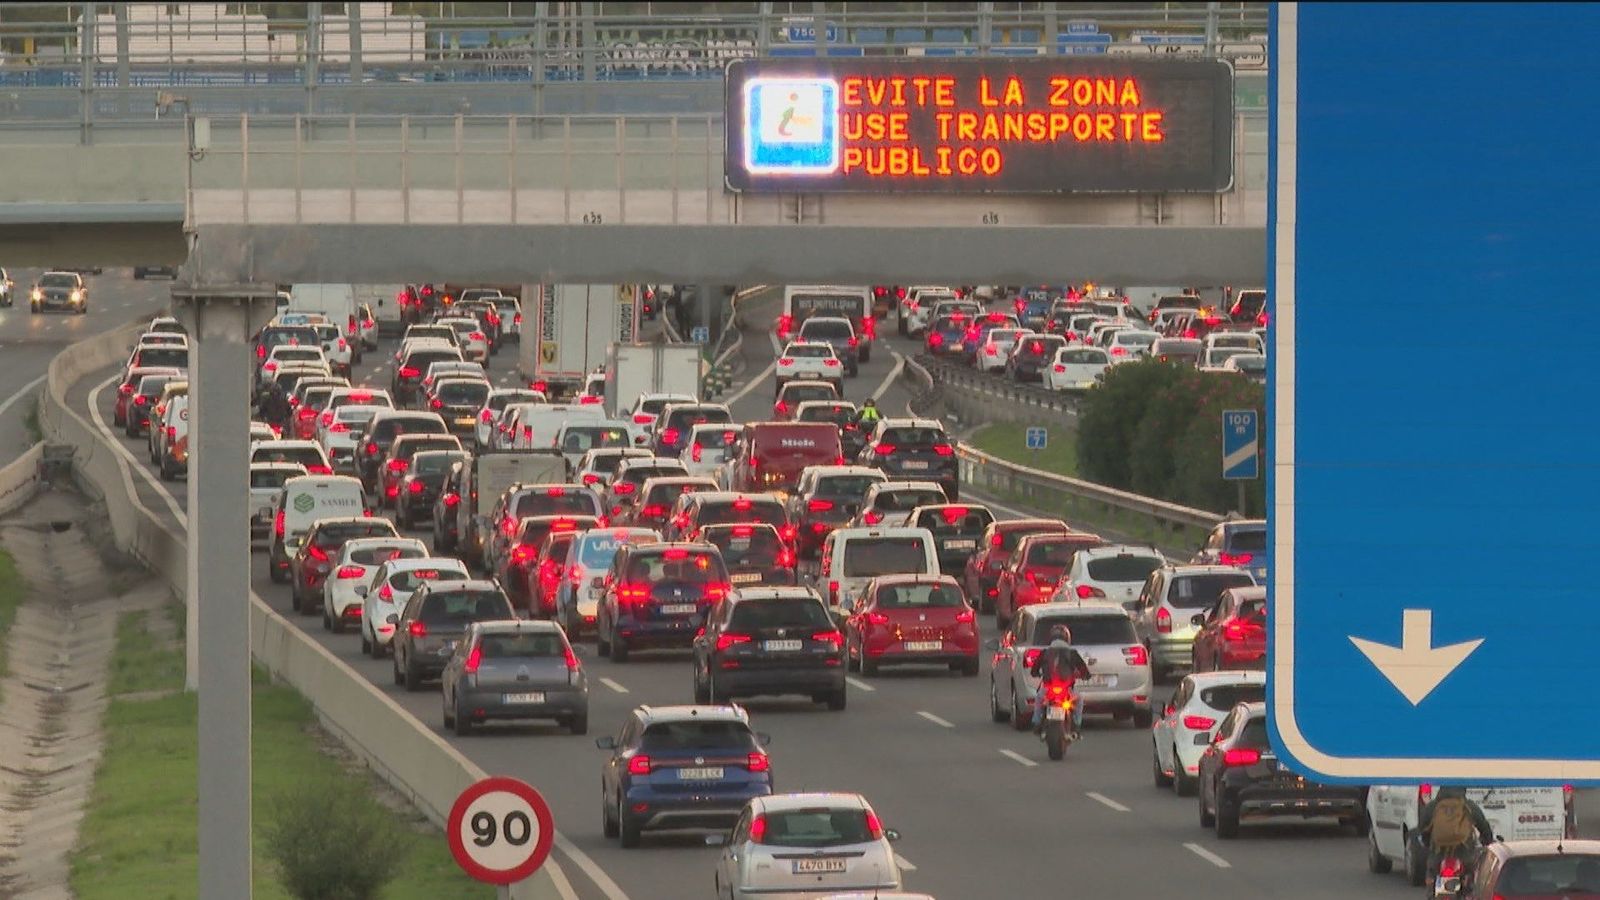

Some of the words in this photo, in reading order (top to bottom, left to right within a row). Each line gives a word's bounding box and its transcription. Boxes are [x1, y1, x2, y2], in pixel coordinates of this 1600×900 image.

[843, 78, 956, 107] EVITE
[981, 78, 1024, 107] LA
[1050, 78, 1140, 107] ZONA
[843, 112, 907, 142] USE
[936, 112, 1164, 142] TRANSPORTE
[843, 147, 1003, 176] PUBLICO
[1228, 415, 1250, 425] 100
[781, 439, 815, 447] Miele
[471, 810, 531, 848] 90
[799, 861, 823, 870] 4470
